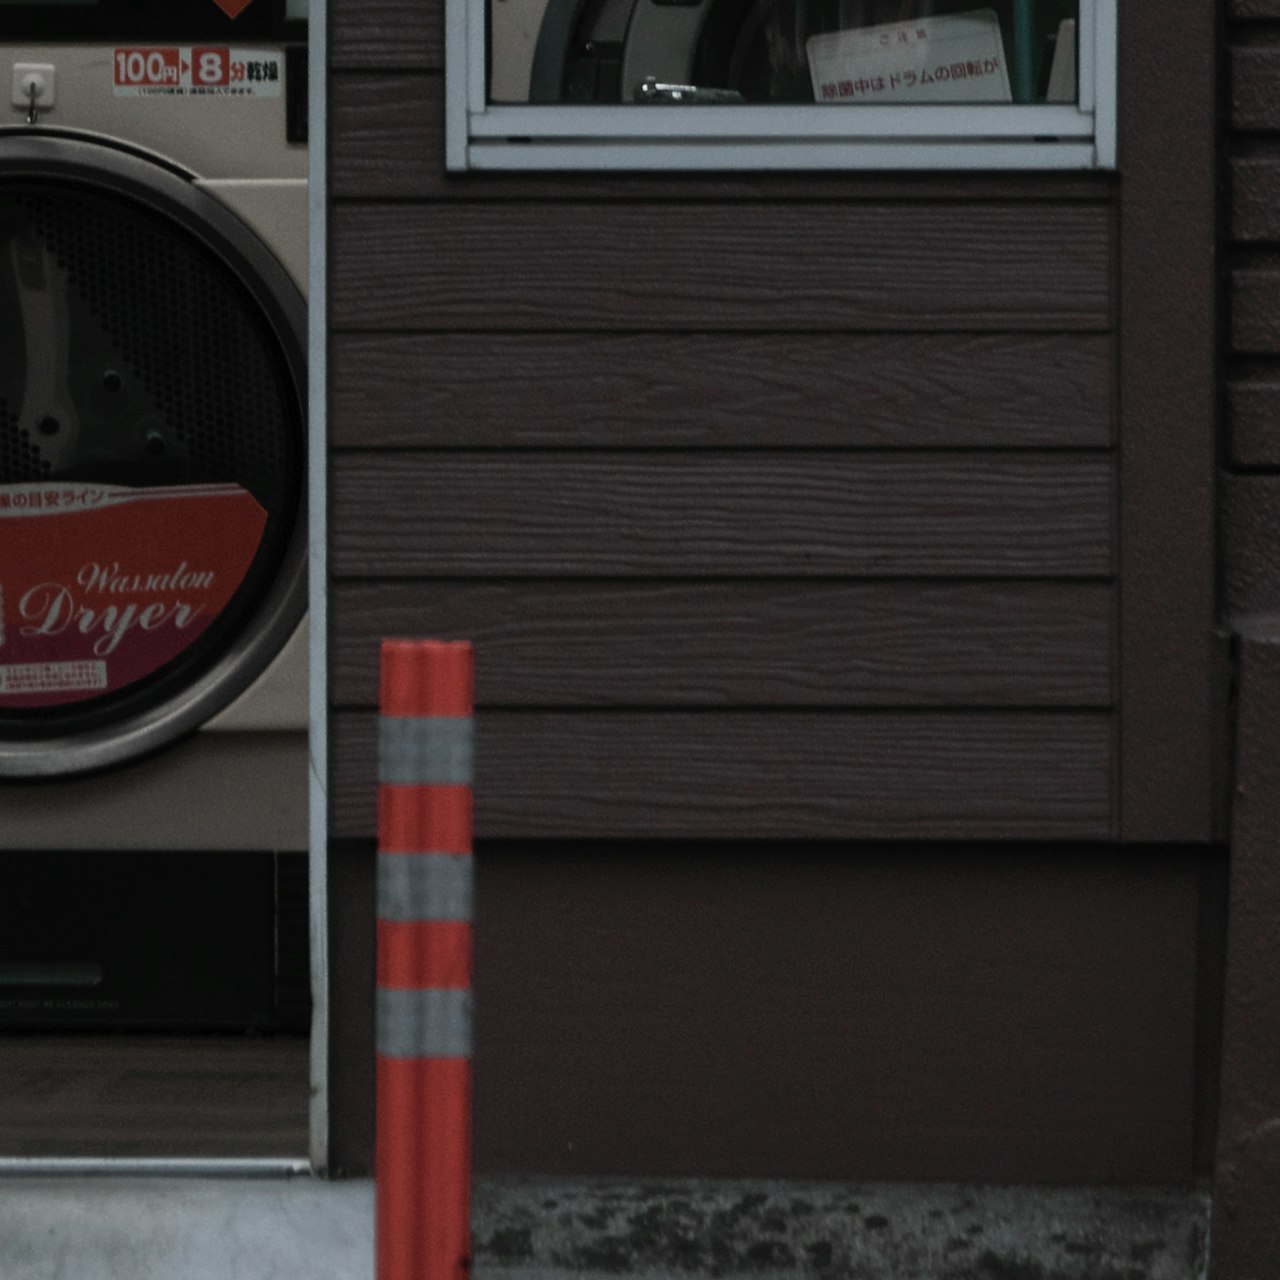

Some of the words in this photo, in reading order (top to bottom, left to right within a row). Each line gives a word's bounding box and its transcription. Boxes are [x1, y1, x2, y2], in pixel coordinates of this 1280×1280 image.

[116, 52, 177, 82] 100円
[821, 58, 998, 99] 除菌中はドラムの回転が
[77, 561, 214, 595] Wassalon
[19, 582, 205, 657] Dryer
